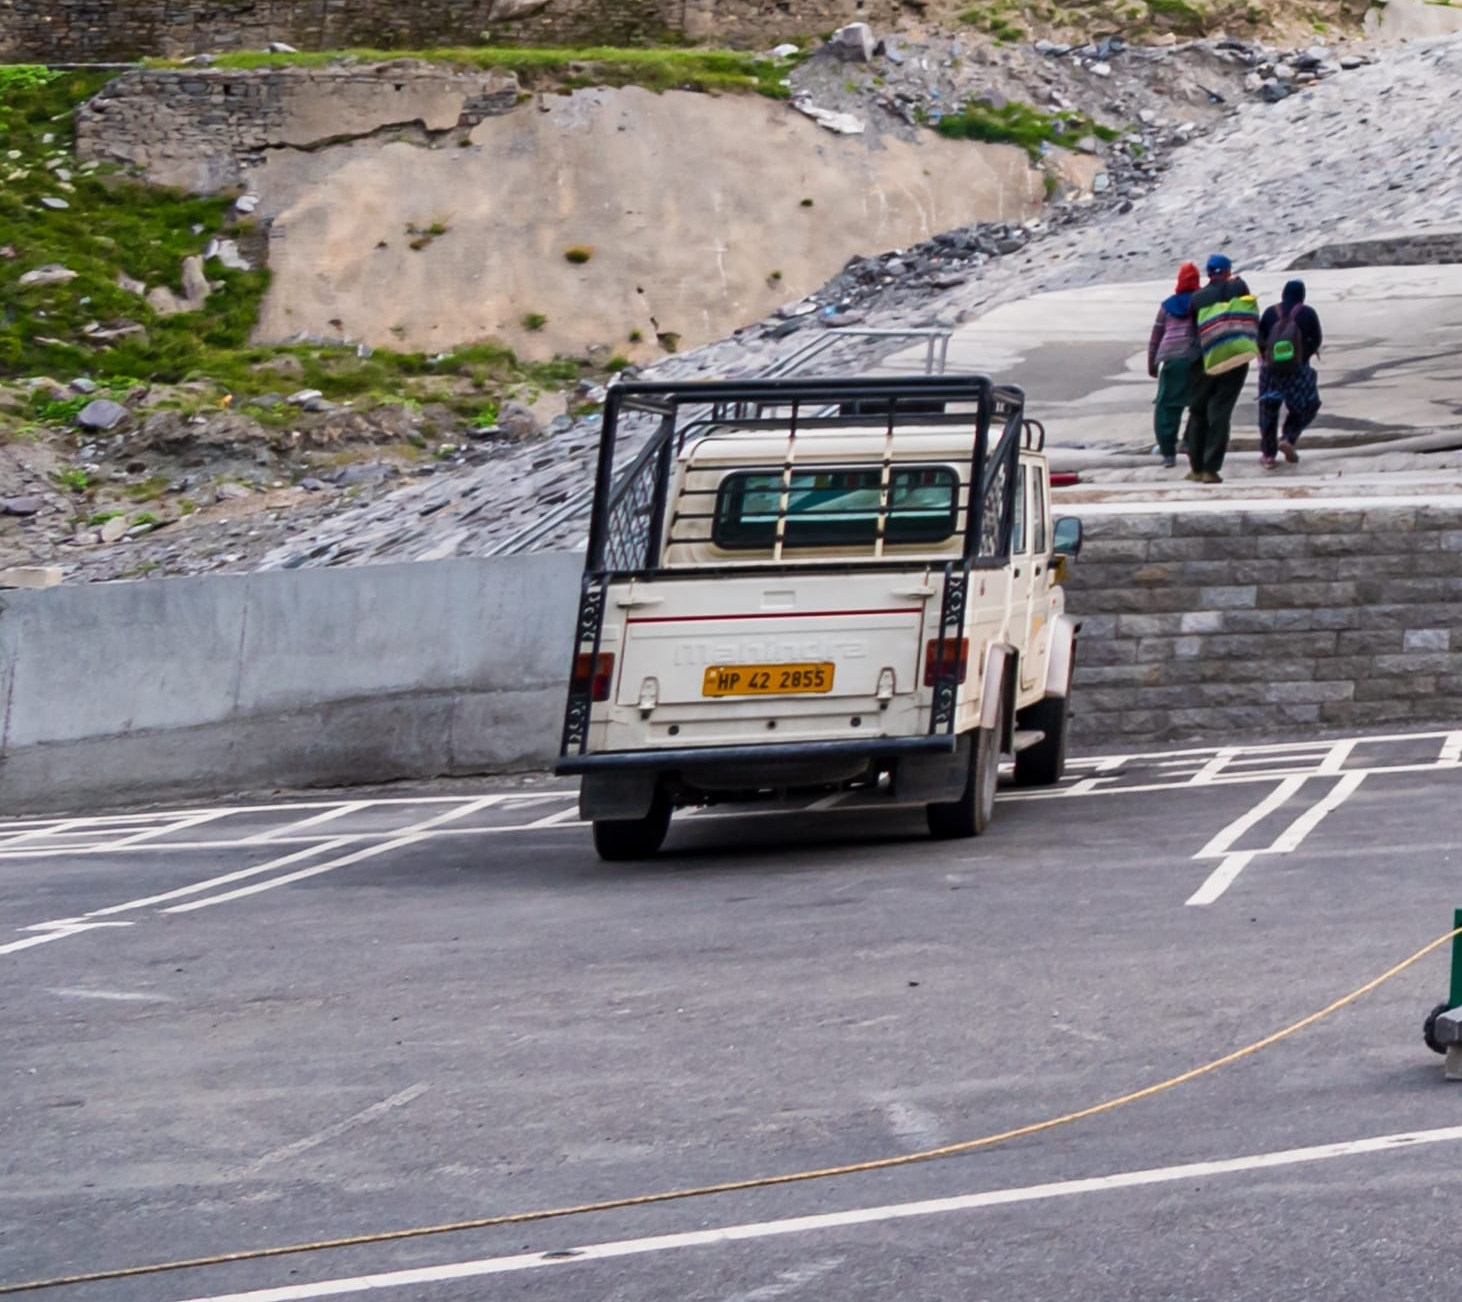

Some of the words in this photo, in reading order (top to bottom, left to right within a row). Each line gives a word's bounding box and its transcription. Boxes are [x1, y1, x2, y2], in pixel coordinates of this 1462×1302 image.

[716, 671, 741, 691] HP
[748, 671, 771, 690] 42
[779, 669, 825, 689] 2855
